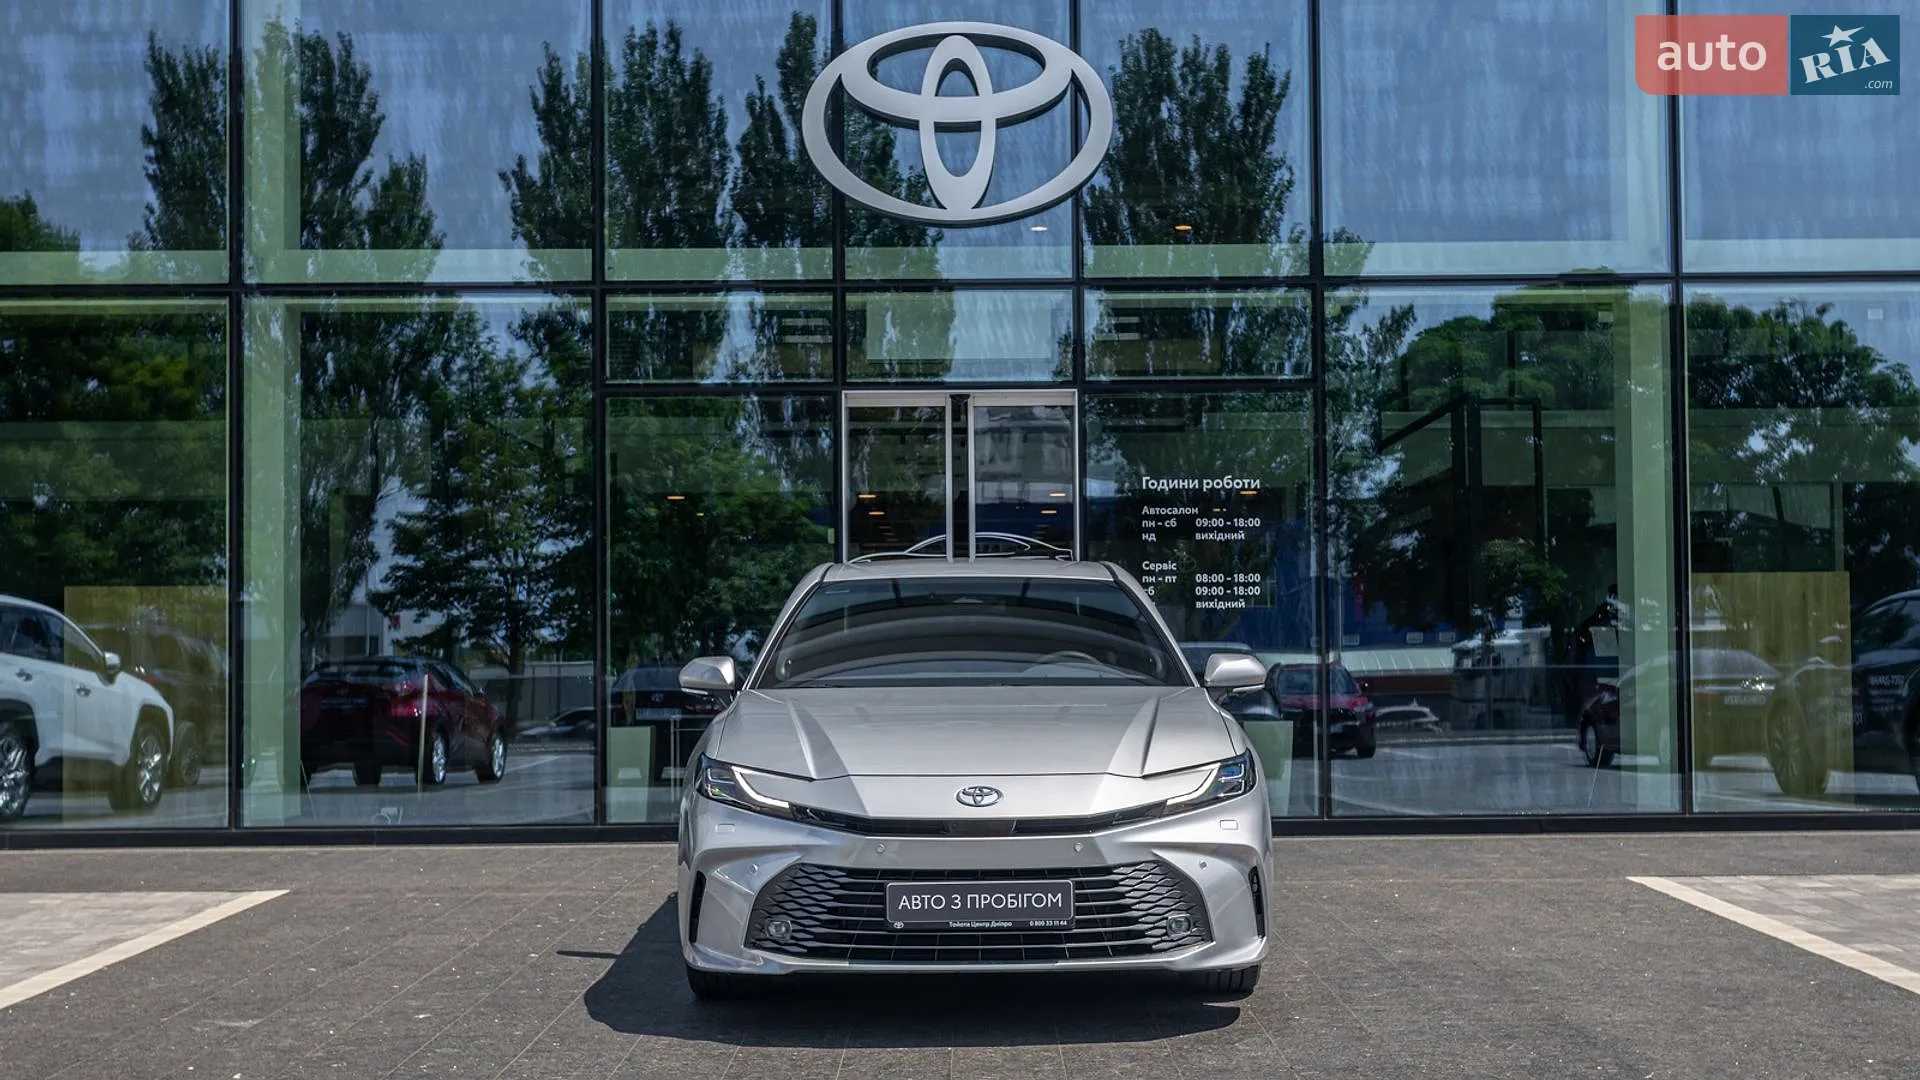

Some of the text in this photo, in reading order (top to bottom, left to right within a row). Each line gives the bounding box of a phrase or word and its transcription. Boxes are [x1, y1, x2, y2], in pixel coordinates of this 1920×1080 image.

[1142, 475, 1260, 491] Години роботи
[1142, 506, 1199, 515] Автосалон
[1165, 518, 1177, 527] сб
[1195, 518, 1224, 527] 09:00
[1234, 518, 1261, 527] 18:00
[1142, 530, 1245, 542] нд вихідний
[1142, 561, 1177, 572] Сервіс
[1142, 575, 1155, 583] пн
[1165, 575, 1177, 583] пт
[1195, 573, 1224, 583] 08:00
[1234, 573, 1261, 583] 18:00
[1195, 586, 1224, 596] 09:00
[1234, 586, 1261, 596] 18:00
[1195, 598, 1246, 609] вихідний
[898, 894, 946, 910] АВТО
[967, 892, 1062, 909] ПРОБІГОМ
[971, 920, 990, 928] Центр
[991, 920, 1013, 928] Дніпро
